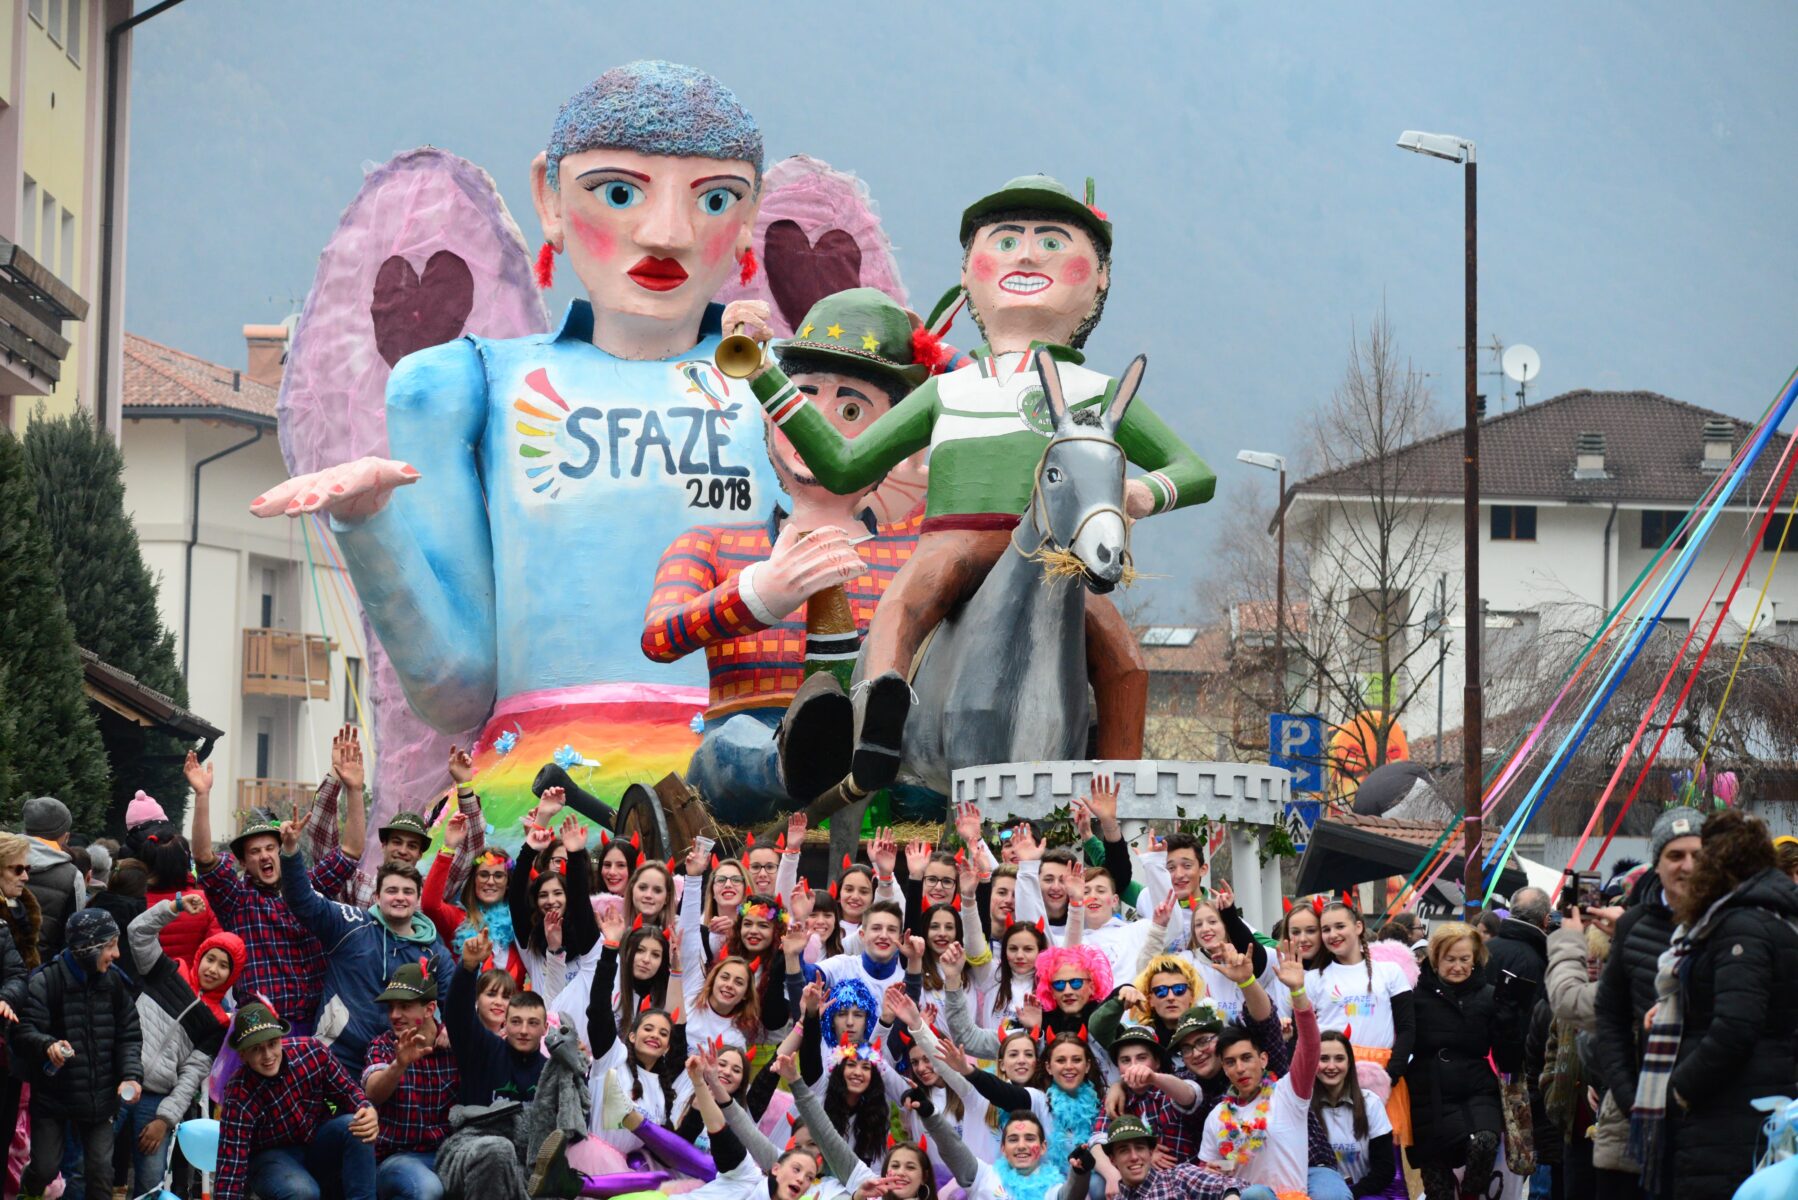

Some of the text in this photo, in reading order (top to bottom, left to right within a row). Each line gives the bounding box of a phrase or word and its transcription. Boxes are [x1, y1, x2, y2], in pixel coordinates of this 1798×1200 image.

[686, 477, 751, 511] 2018
[1281, 719, 1311, 757] P
[1217, 1001, 1238, 1010] FAZE
